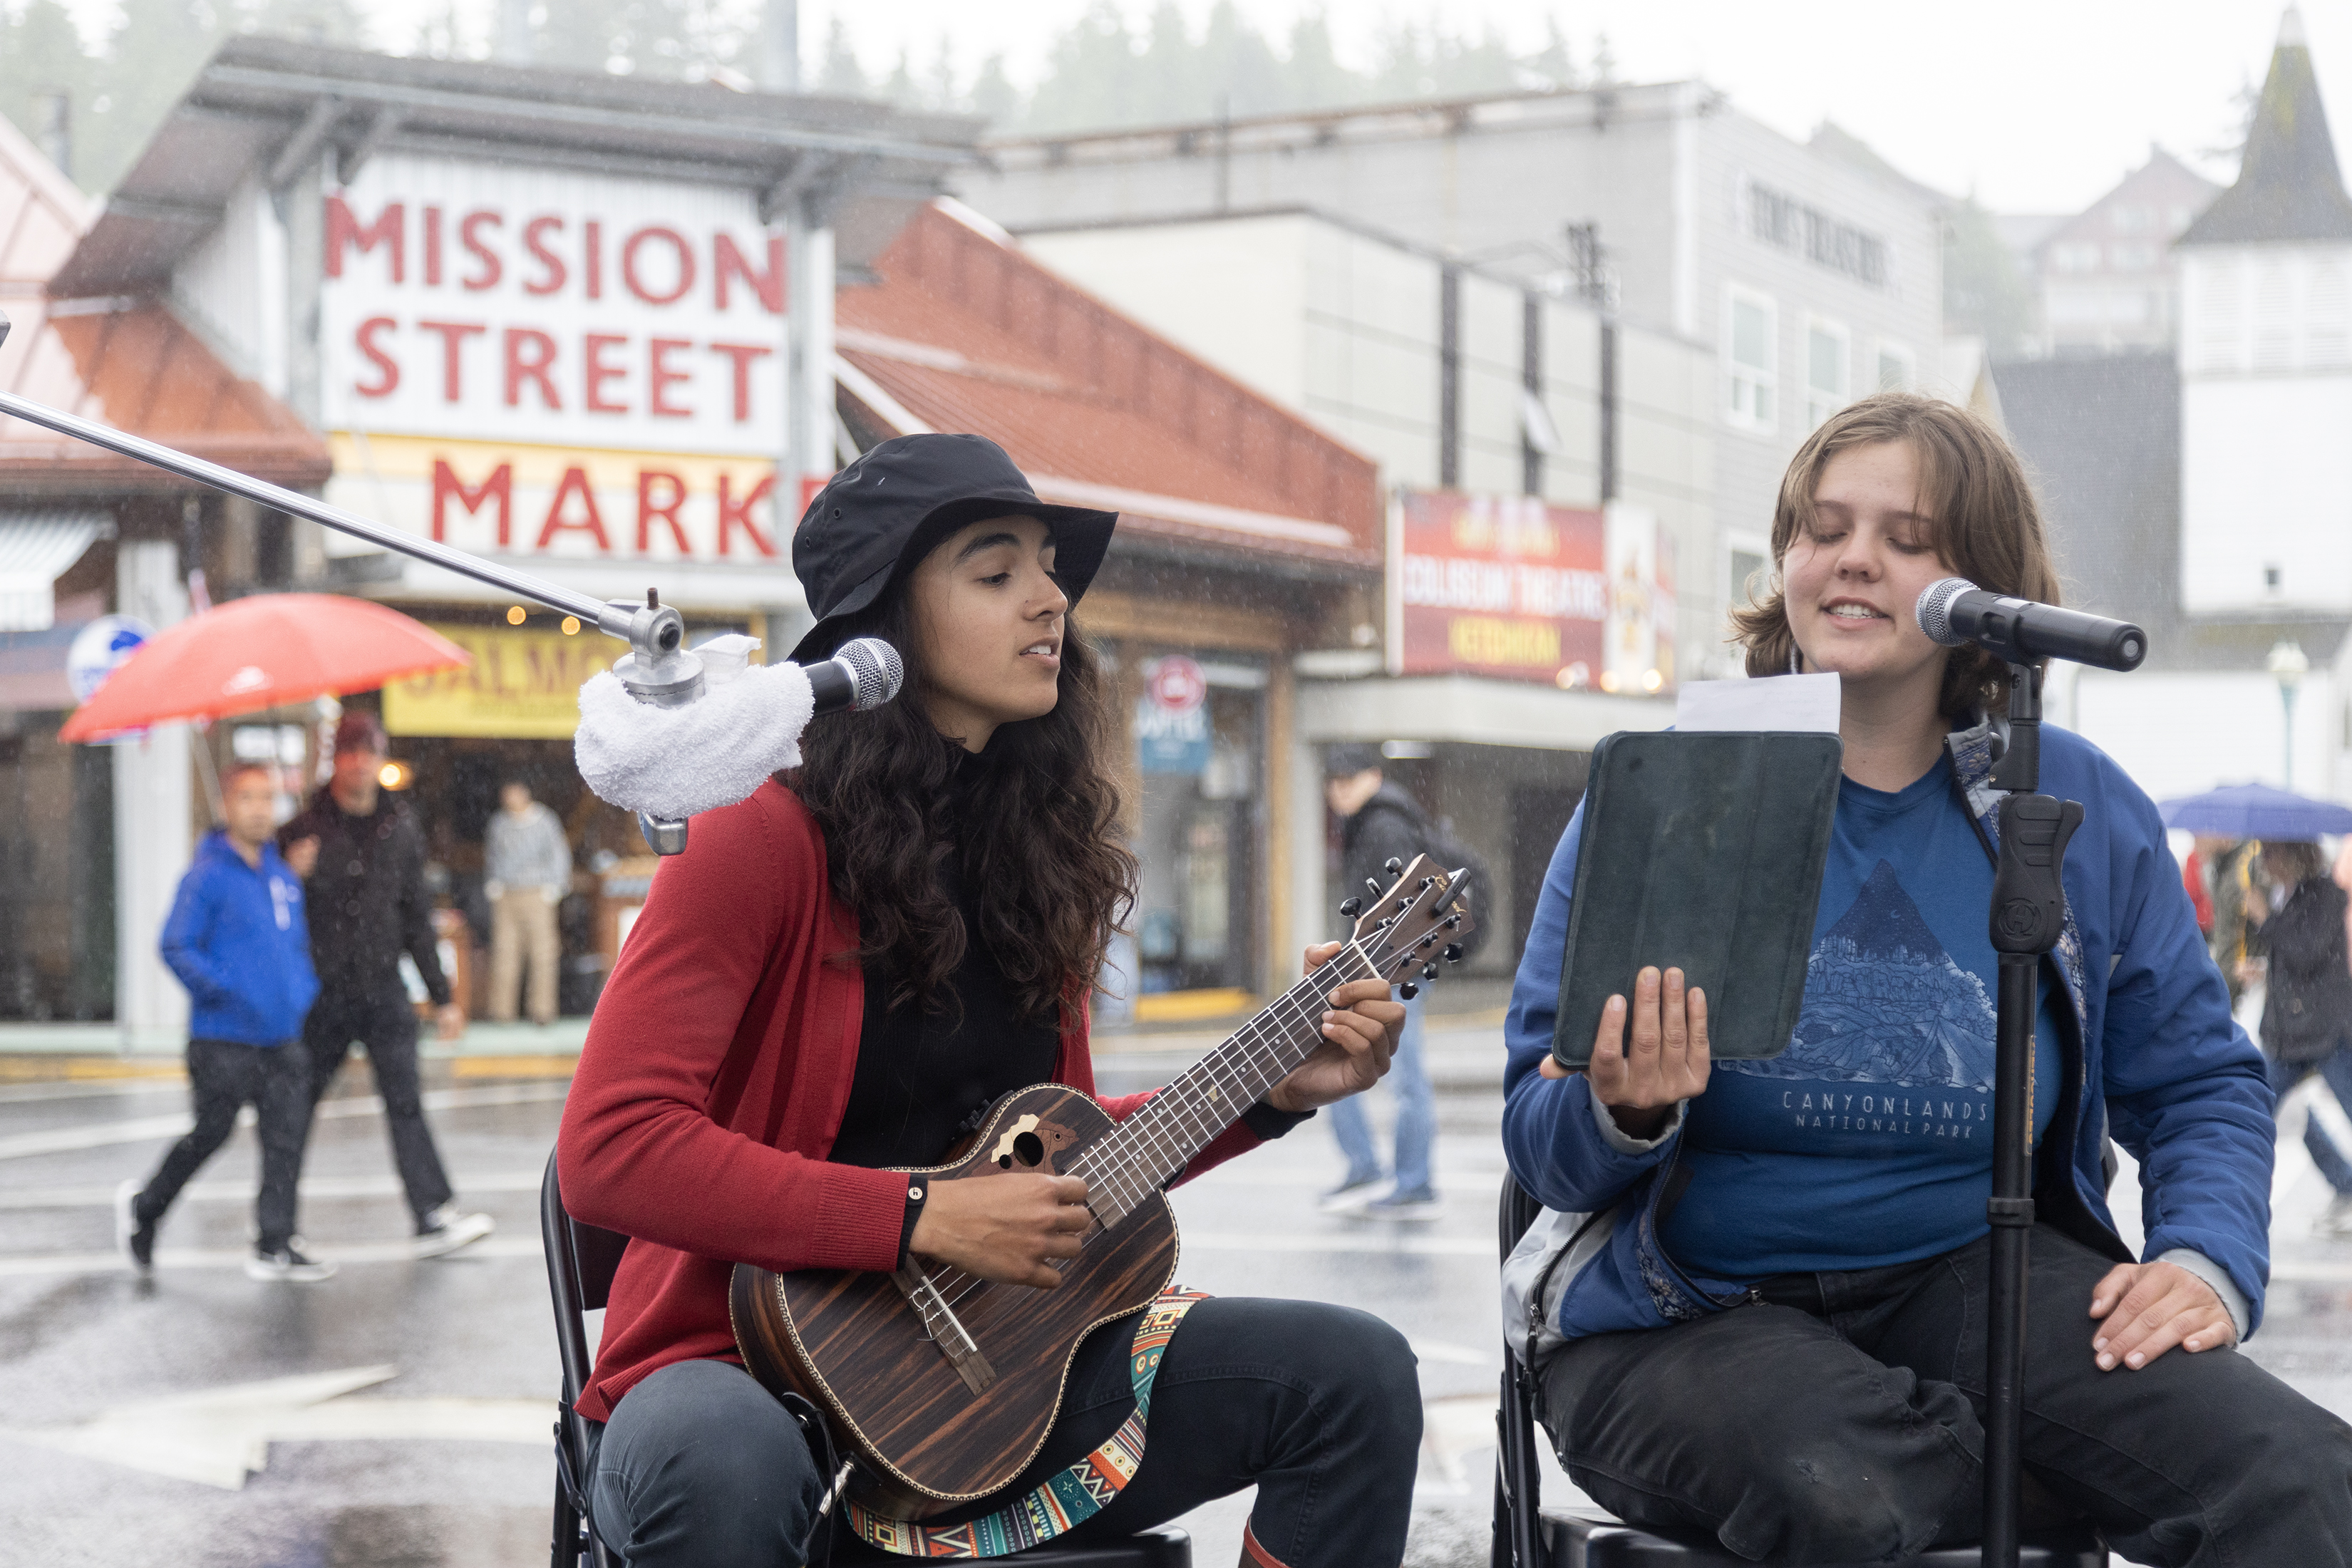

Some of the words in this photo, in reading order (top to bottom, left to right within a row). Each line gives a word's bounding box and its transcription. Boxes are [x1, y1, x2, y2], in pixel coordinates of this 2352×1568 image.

[324, 192, 785, 314] MISSION
[356, 316, 773, 422] STREET
[1783, 1091, 1987, 1121] CANYONLANDS
[1796, 1114, 1911, 1134] NATIONAL
[1924, 1123, 1973, 1139] PARK
